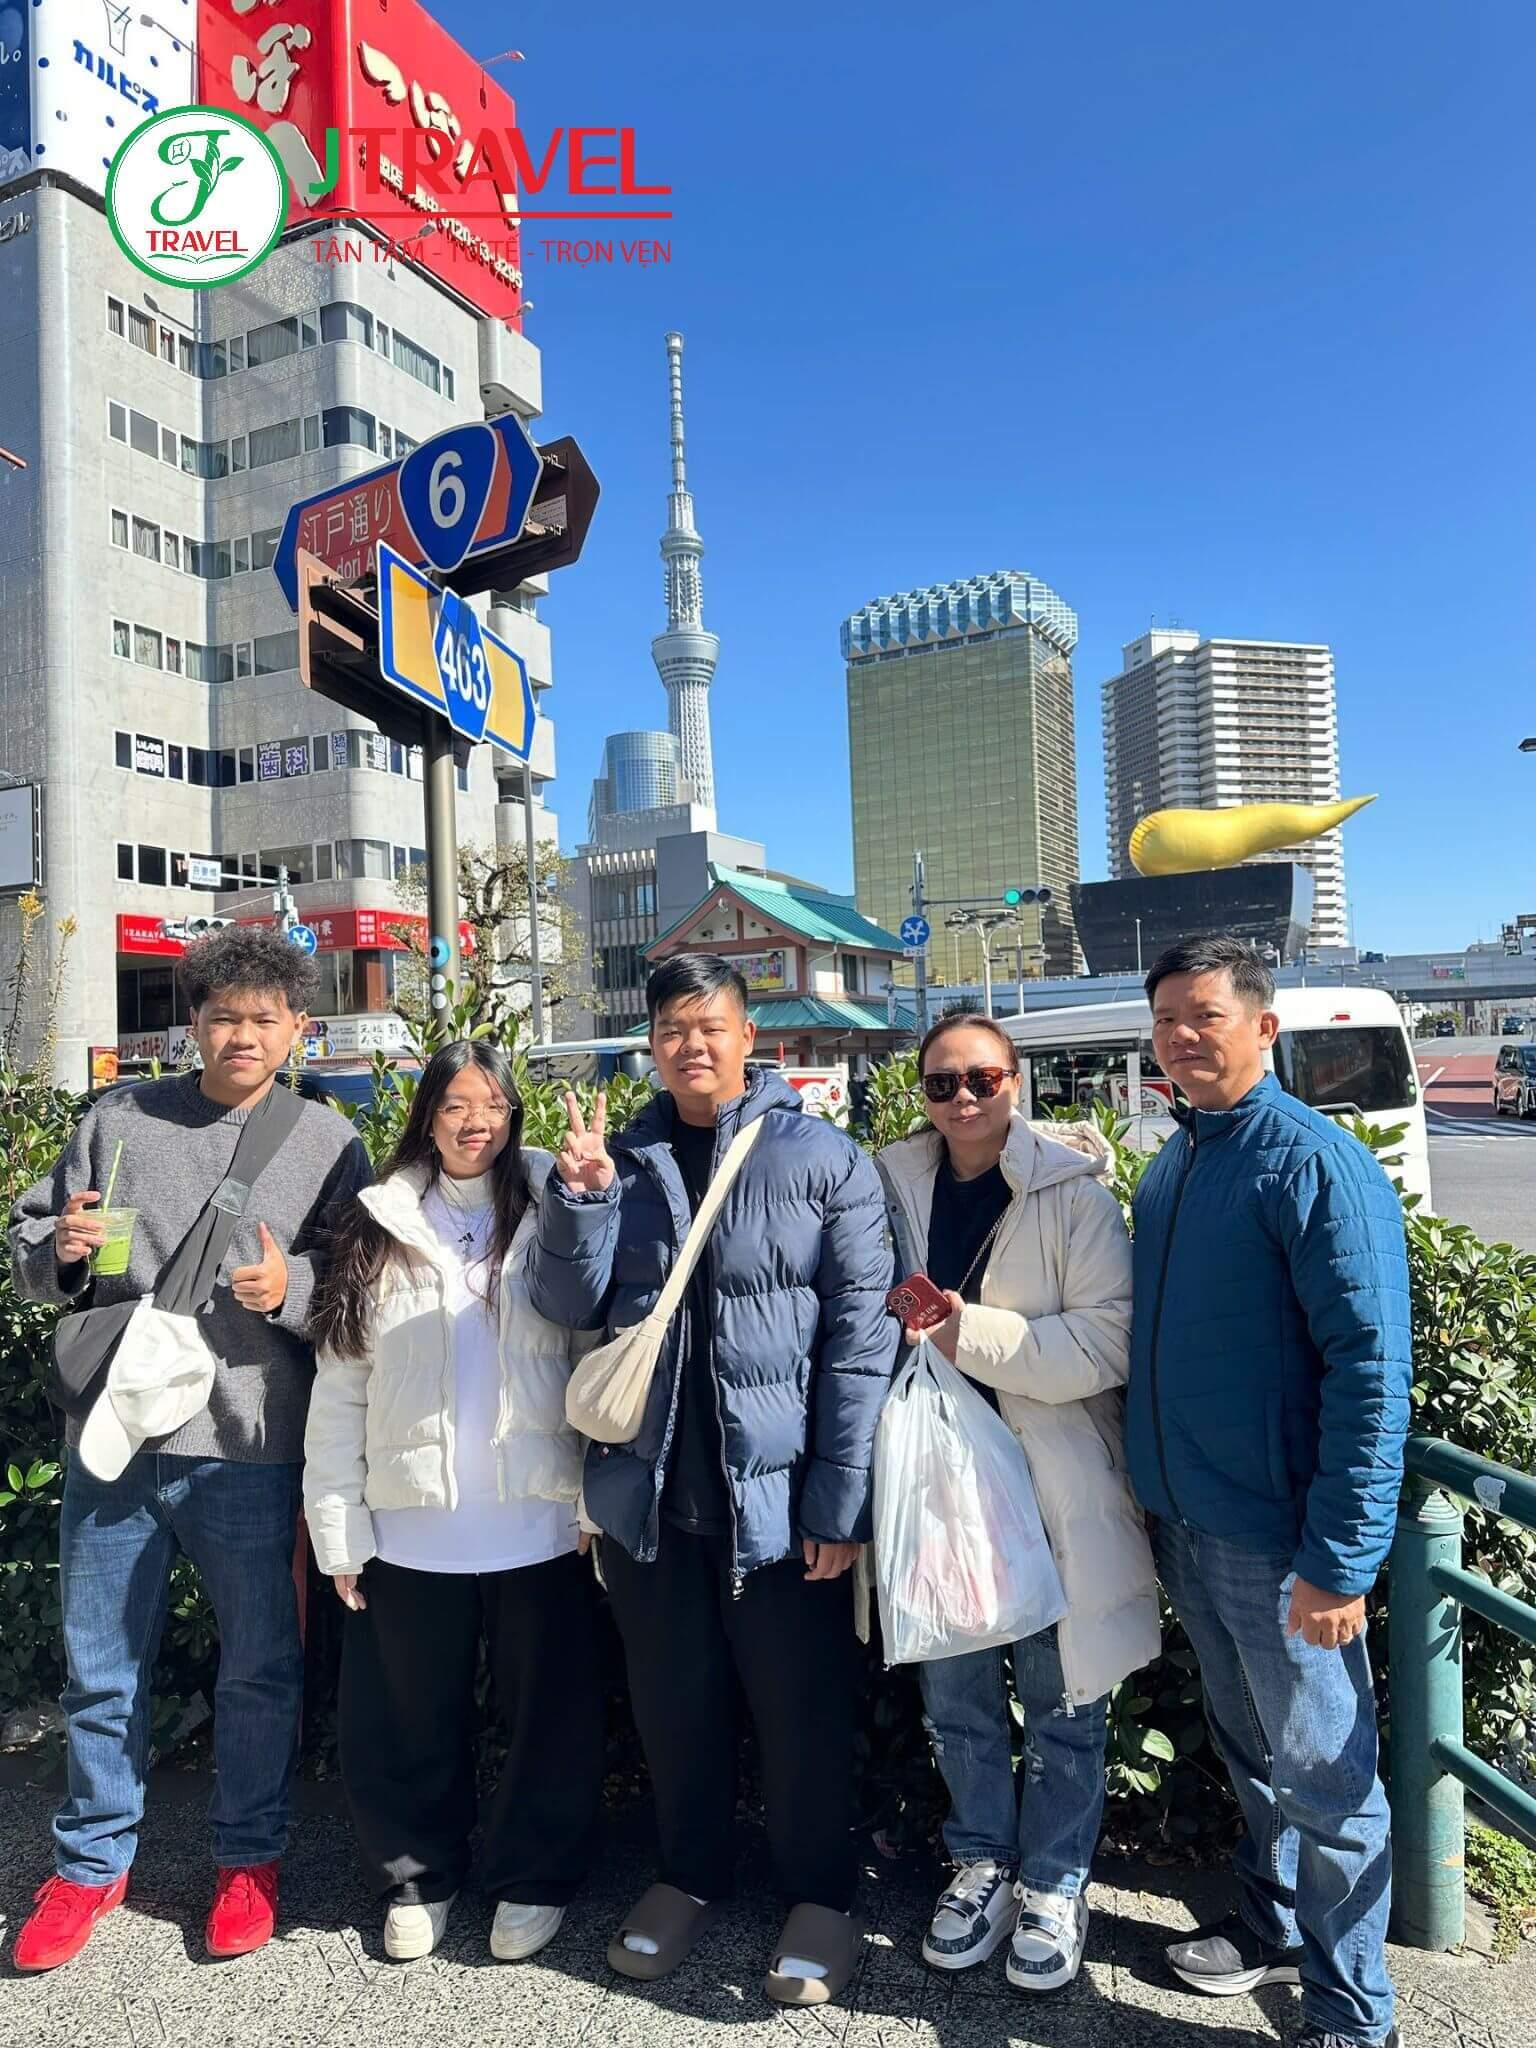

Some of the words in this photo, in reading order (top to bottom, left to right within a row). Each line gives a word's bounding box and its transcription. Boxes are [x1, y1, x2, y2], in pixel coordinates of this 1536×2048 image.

[73, 39, 160, 116] カルピス
[303, 483, 392, 558] 江戸通り
[428, 449, 466, 529] 6
[440, 624, 487, 711] 463
[259, 745, 308, 780] 歯科
